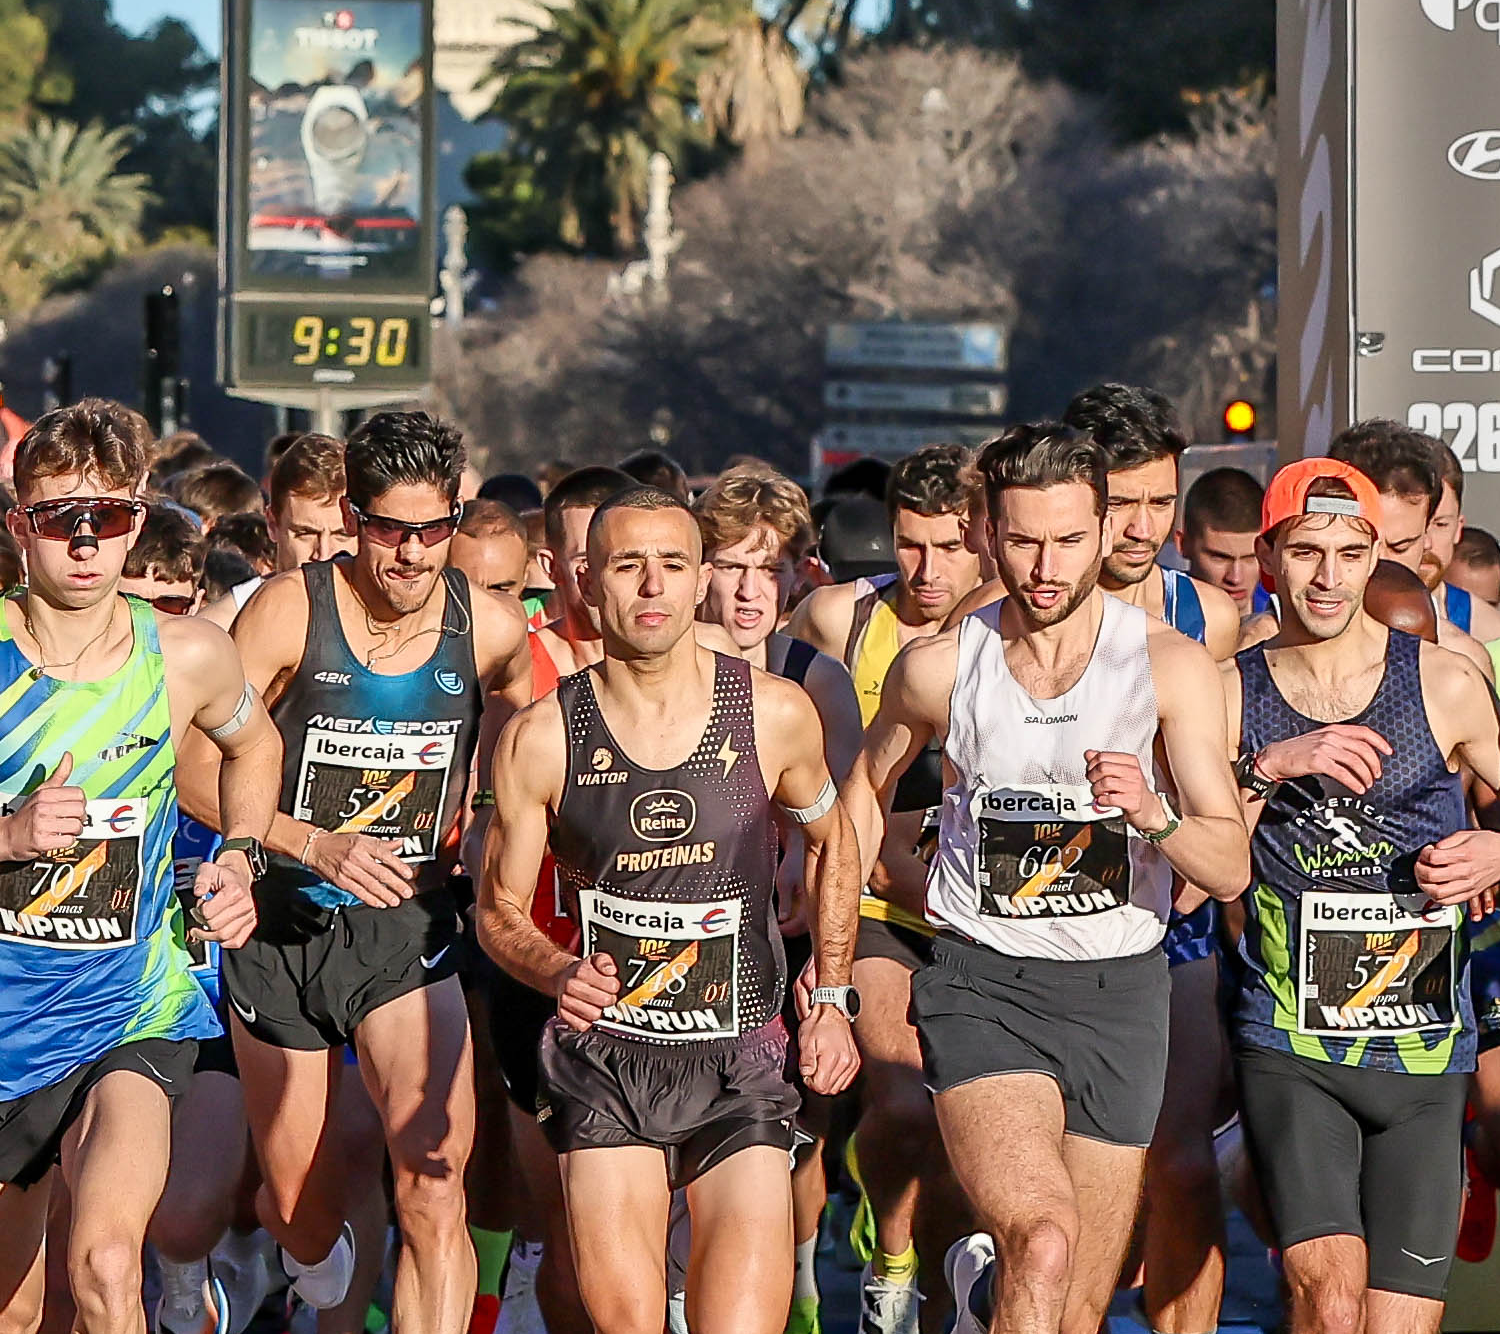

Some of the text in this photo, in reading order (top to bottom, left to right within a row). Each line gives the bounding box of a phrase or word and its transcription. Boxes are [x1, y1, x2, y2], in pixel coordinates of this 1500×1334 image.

[294, 317, 409, 366] 9:30
[314, 671, 352, 685] 42K
[1024, 714, 1078, 724] SALOMON
[316, 739, 404, 762] Ibercaja
[361, 770, 391, 785] 10K
[577, 771, 628, 786] VIATOR
[339, 788, 407, 821] 526
[1295, 797, 1385, 827] ATLETICA
[640, 816, 686, 831] Reina
[1034, 823, 1065, 841] 10K
[616, 842, 716, 872] PROTEINAS
[1019, 845, 1084, 879] 602
[1294, 841, 1394, 874] Winner
[30, 862, 96, 898] 701
[1311, 866, 1382, 878] FOLIGNO
[1034, 881, 1074, 892] daniel
[40, 903, 84, 914] thomas
[993, 889, 1117, 915] KIPRUN
[1313, 902, 1405, 924] Ibercaja
[0, 907, 123, 940] KIPRUN
[593, 898, 685, 933] Ibercaja
[638, 939, 671, 956] 10K
[1365, 933, 1396, 952] 10K
[626, 958, 691, 994] 748
[1346, 953, 1411, 990] 572
[703, 981, 728, 1004] 01
[1365, 994, 1399, 1006] pippo
[603, 1003, 721, 1031] KIPRUN
[1320, 1002, 1441, 1028] KIPRUN
